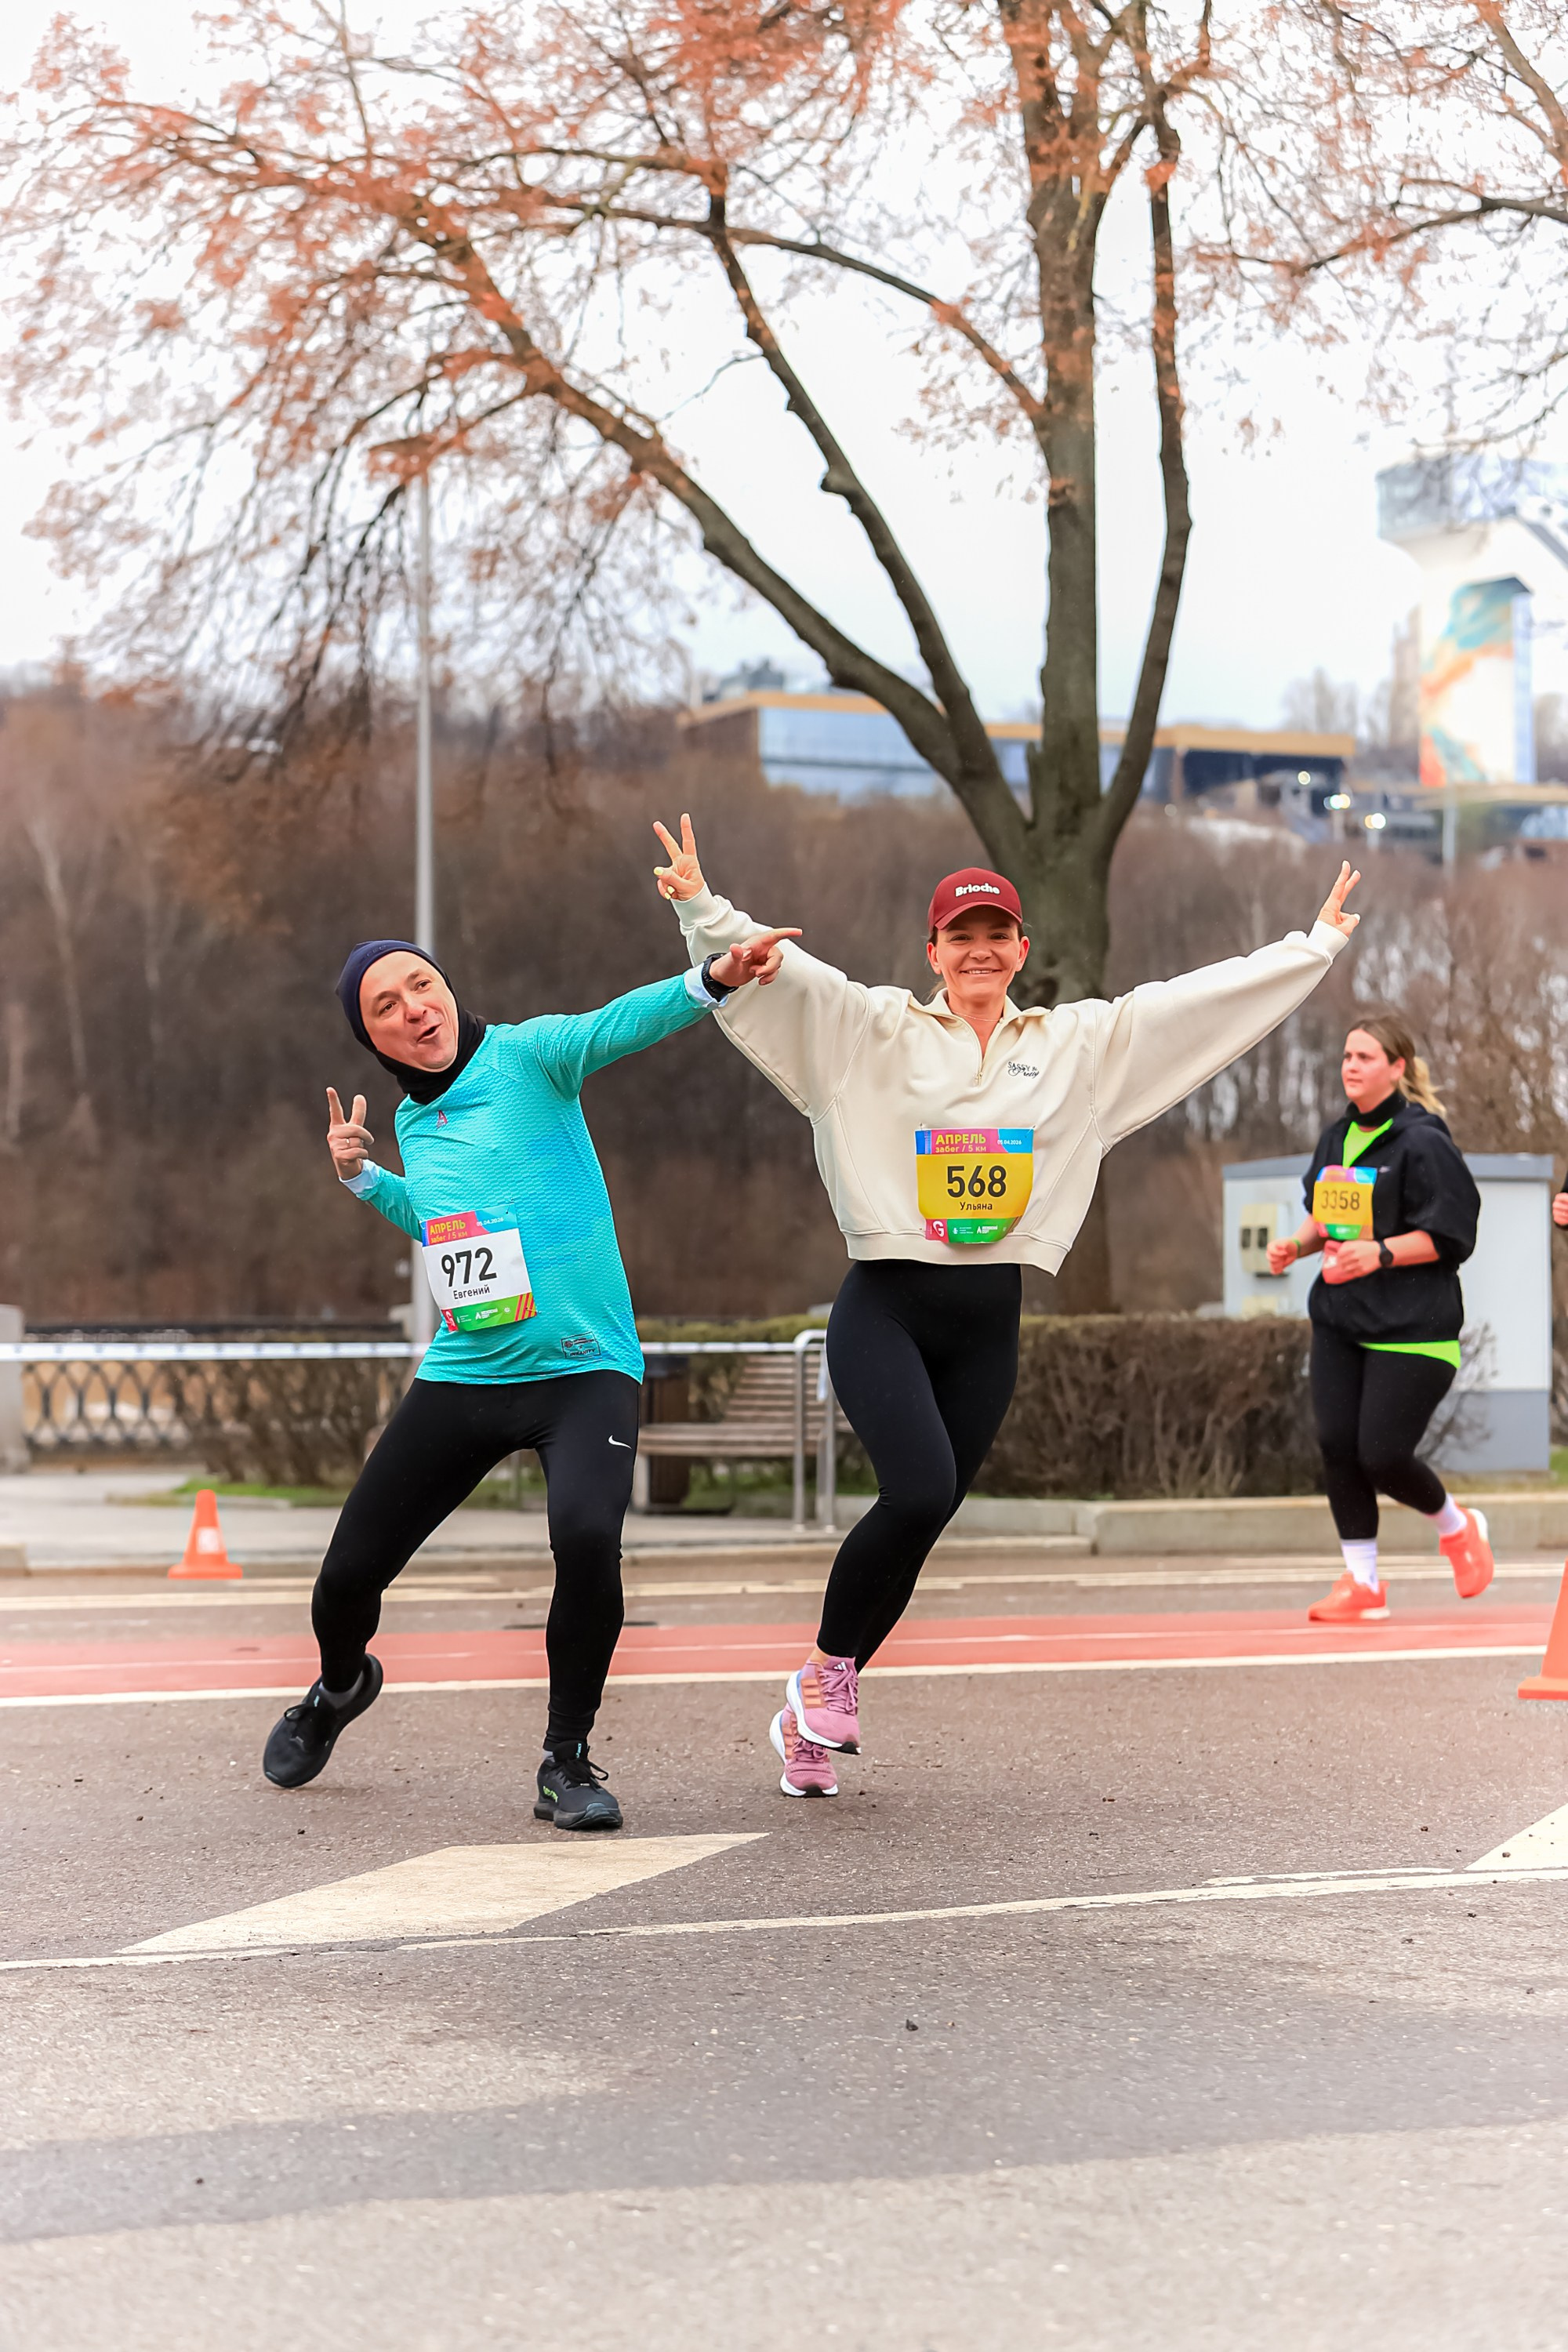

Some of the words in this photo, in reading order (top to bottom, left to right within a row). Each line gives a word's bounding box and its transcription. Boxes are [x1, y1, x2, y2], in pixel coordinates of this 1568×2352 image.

[956, 883, 1000, 897] Brioche
[935, 1134, 986, 1145] АПРЕЛЬ
[947, 1165, 1007, 1198] 568
[960, 1202, 993, 1210] Ульяна
[1321, 1190, 1360, 1210] 3358
[430, 1220, 466, 1235] АПРЕЛЬ
[441, 1247, 497, 1287] 972
[453, 1284, 490, 1300] Евгений
